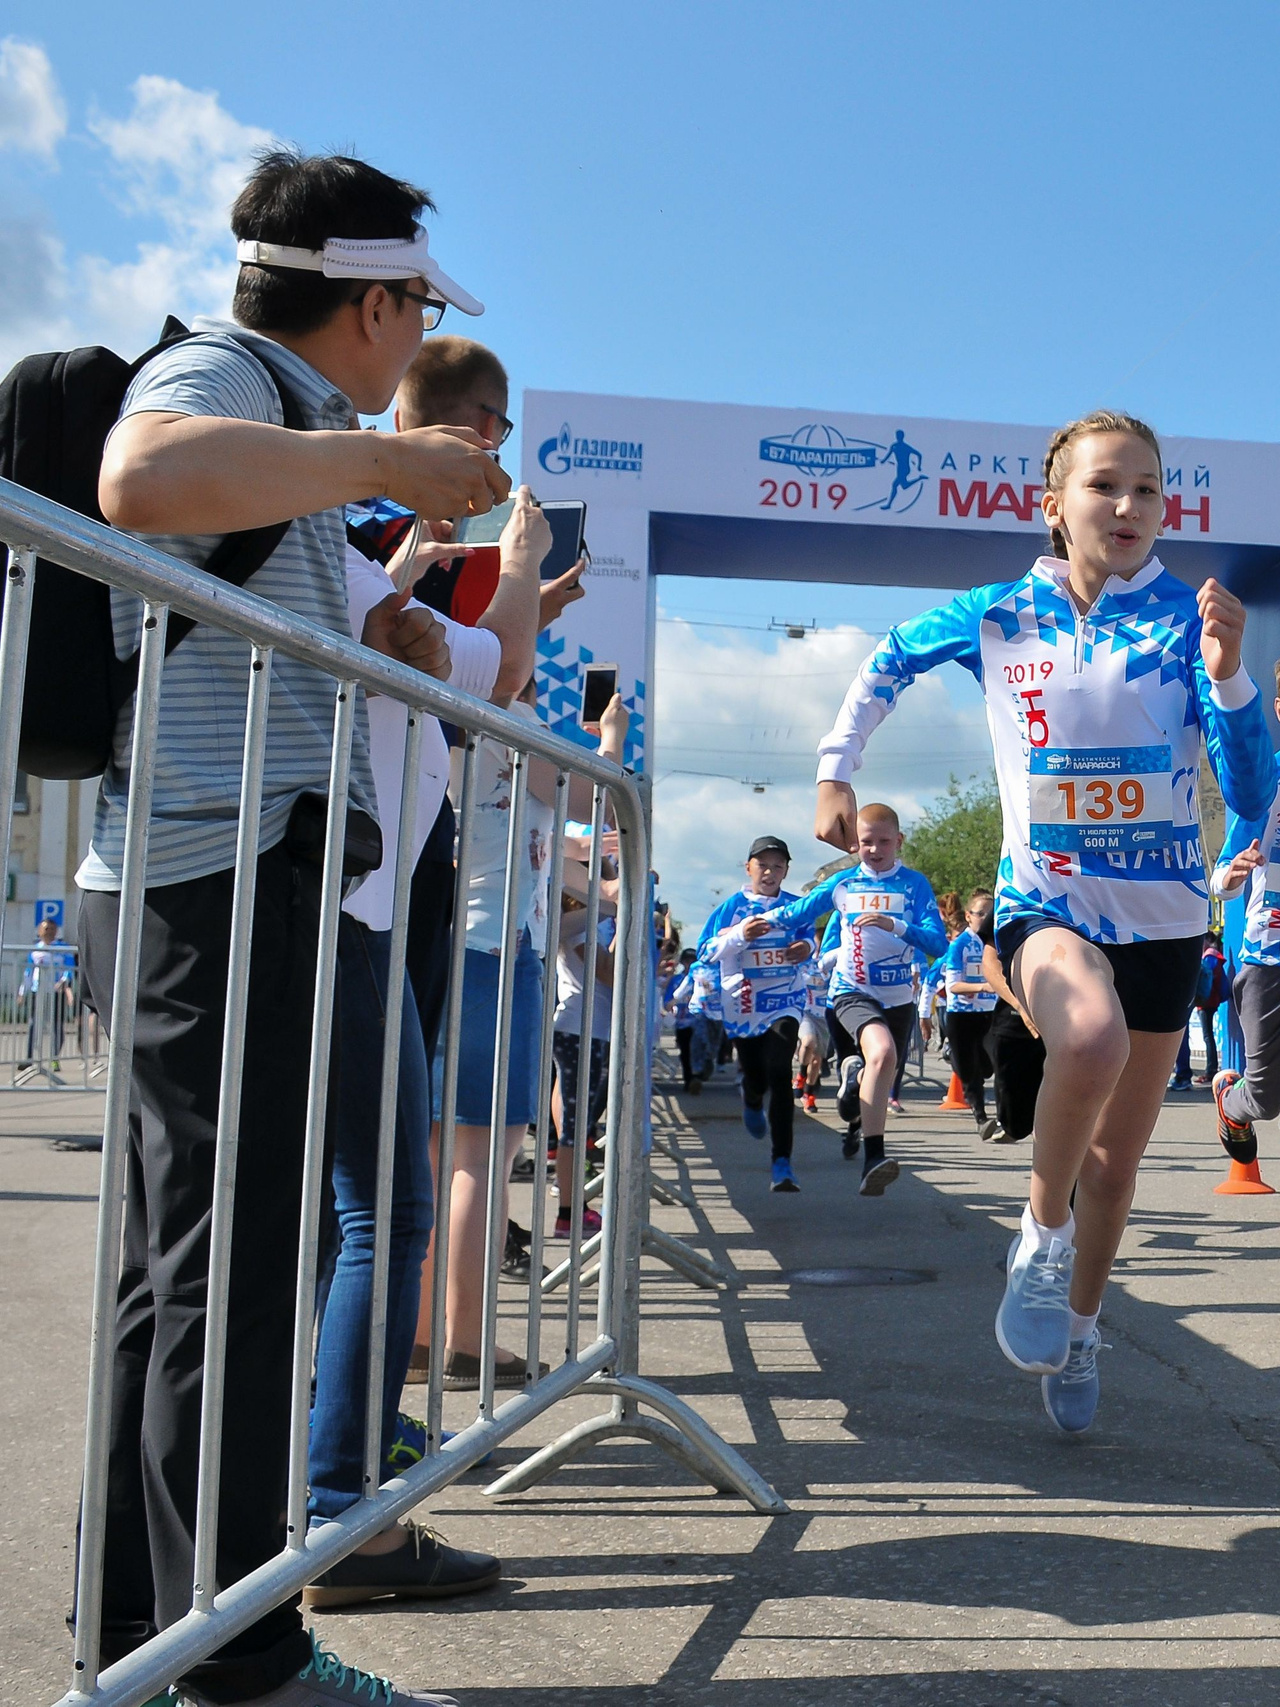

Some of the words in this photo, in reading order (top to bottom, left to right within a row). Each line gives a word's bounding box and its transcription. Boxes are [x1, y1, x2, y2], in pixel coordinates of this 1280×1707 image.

[573, 438, 643, 459] ГАЗПРОМ
[941, 452, 1210, 488] АРКТИЙ
[759, 478, 847, 510] 2019
[939, 478, 1210, 532] МАРН
[591, 554, 625, 565] ussia
[1003, 660, 1054, 684] 2019
[1073, 761, 1121, 770] МАРАФОН
[1057, 779, 1145, 821] 139
[1084, 837, 1105, 848] 600
[1108, 837, 1119, 847] М
[859, 895, 891, 910] 141
[753, 950, 784, 966] 135
[852, 924, 866, 985] МАРАФО
[880, 969, 897, 982] 67
